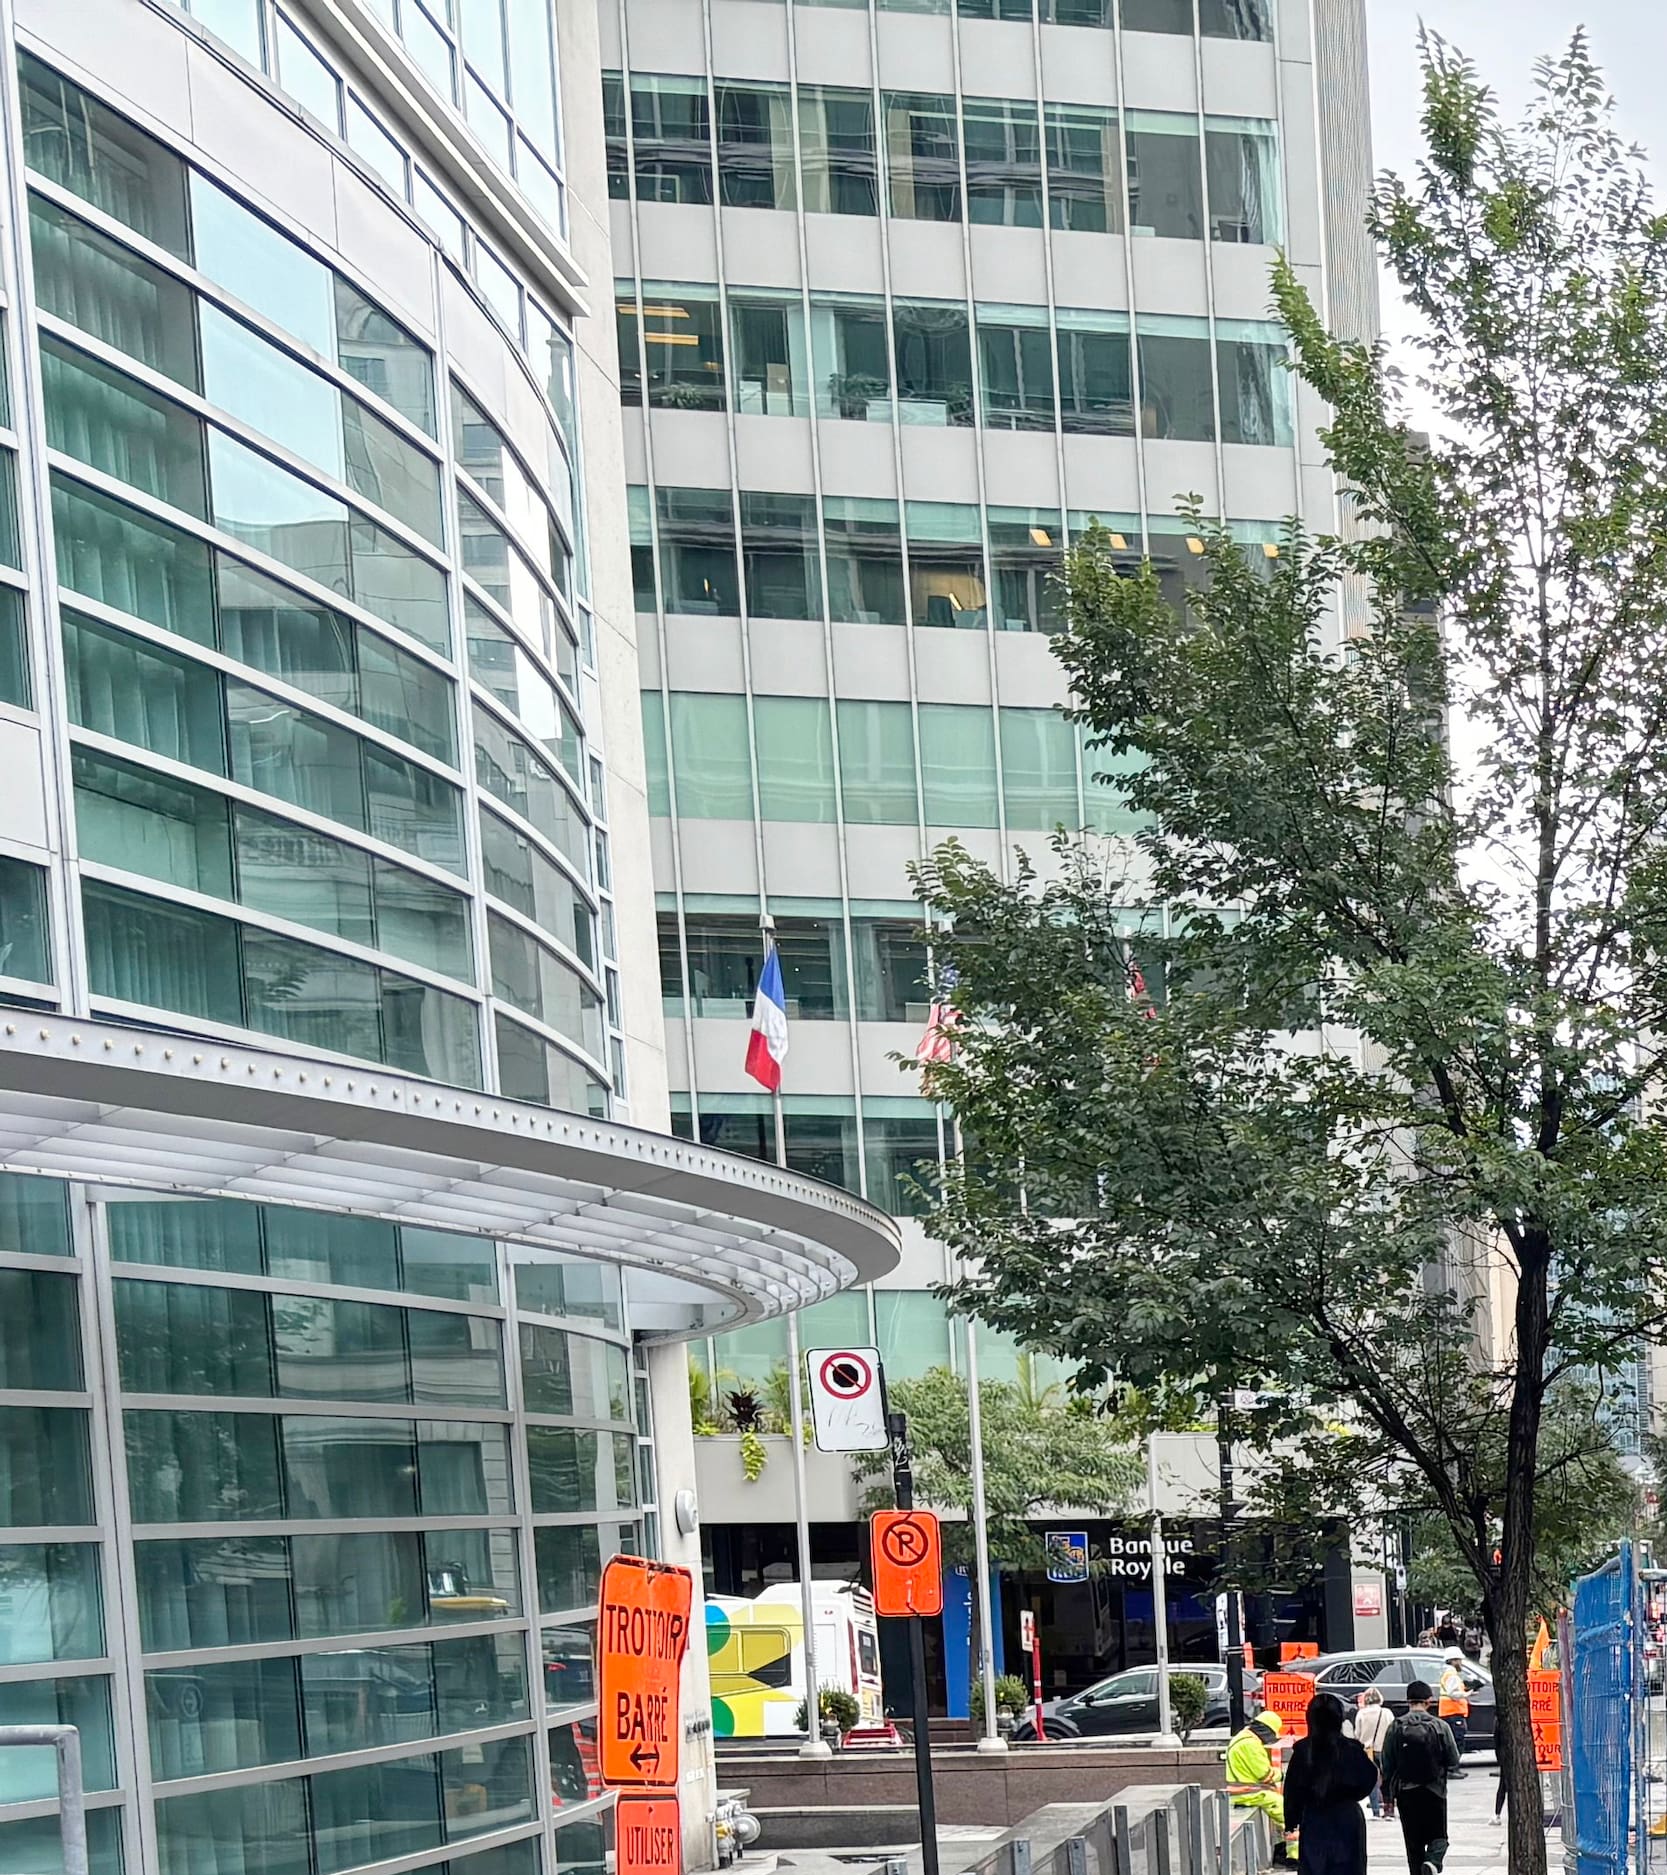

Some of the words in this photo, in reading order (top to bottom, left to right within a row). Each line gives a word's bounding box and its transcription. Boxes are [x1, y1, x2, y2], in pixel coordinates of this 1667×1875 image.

[1109, 1537, 1194, 1555] Banue
[1111, 1558, 1186, 1580] Royle
[605, 1603, 683, 1660] TROTTOIR
[1527, 1681, 1559, 1693] TTOIR
[616, 1686, 668, 1743] BARRÉ
[1531, 1695, 1552, 1712] RRÉ
[626, 1825, 674, 1866] UTILISER
